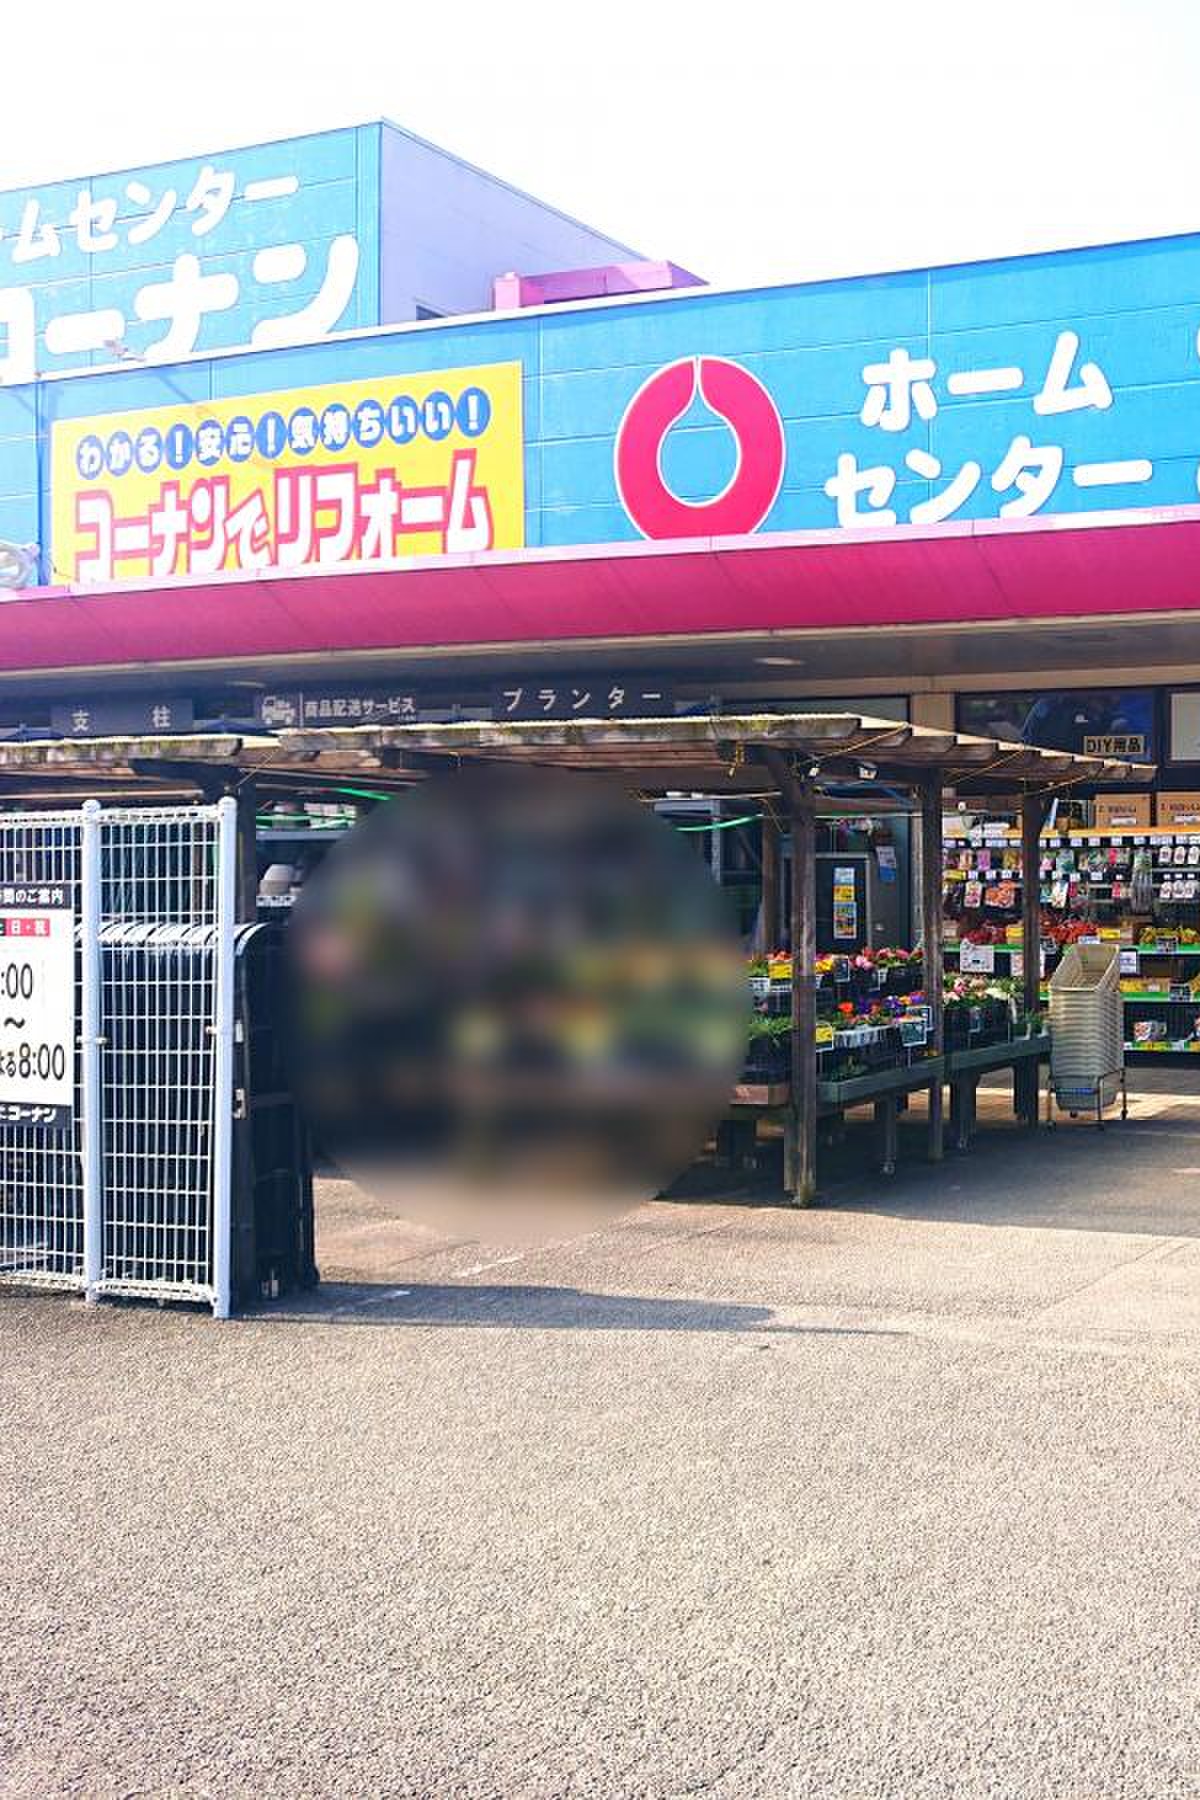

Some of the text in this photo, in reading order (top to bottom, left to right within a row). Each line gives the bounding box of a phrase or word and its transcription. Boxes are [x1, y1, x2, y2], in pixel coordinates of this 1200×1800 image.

[0, 166, 299, 263] ムセンター
[861, 331, 1112, 431] ホーム
[825, 436, 1153, 528] センター
[75, 448, 493, 583] コーナンでリフォーム
[71, 705, 171, 732] 支柱
[503, 685, 661, 711] プランター
[0, 887, 64, 905] 間のご案内
[0, 1105, 57, 1123] コーナン
